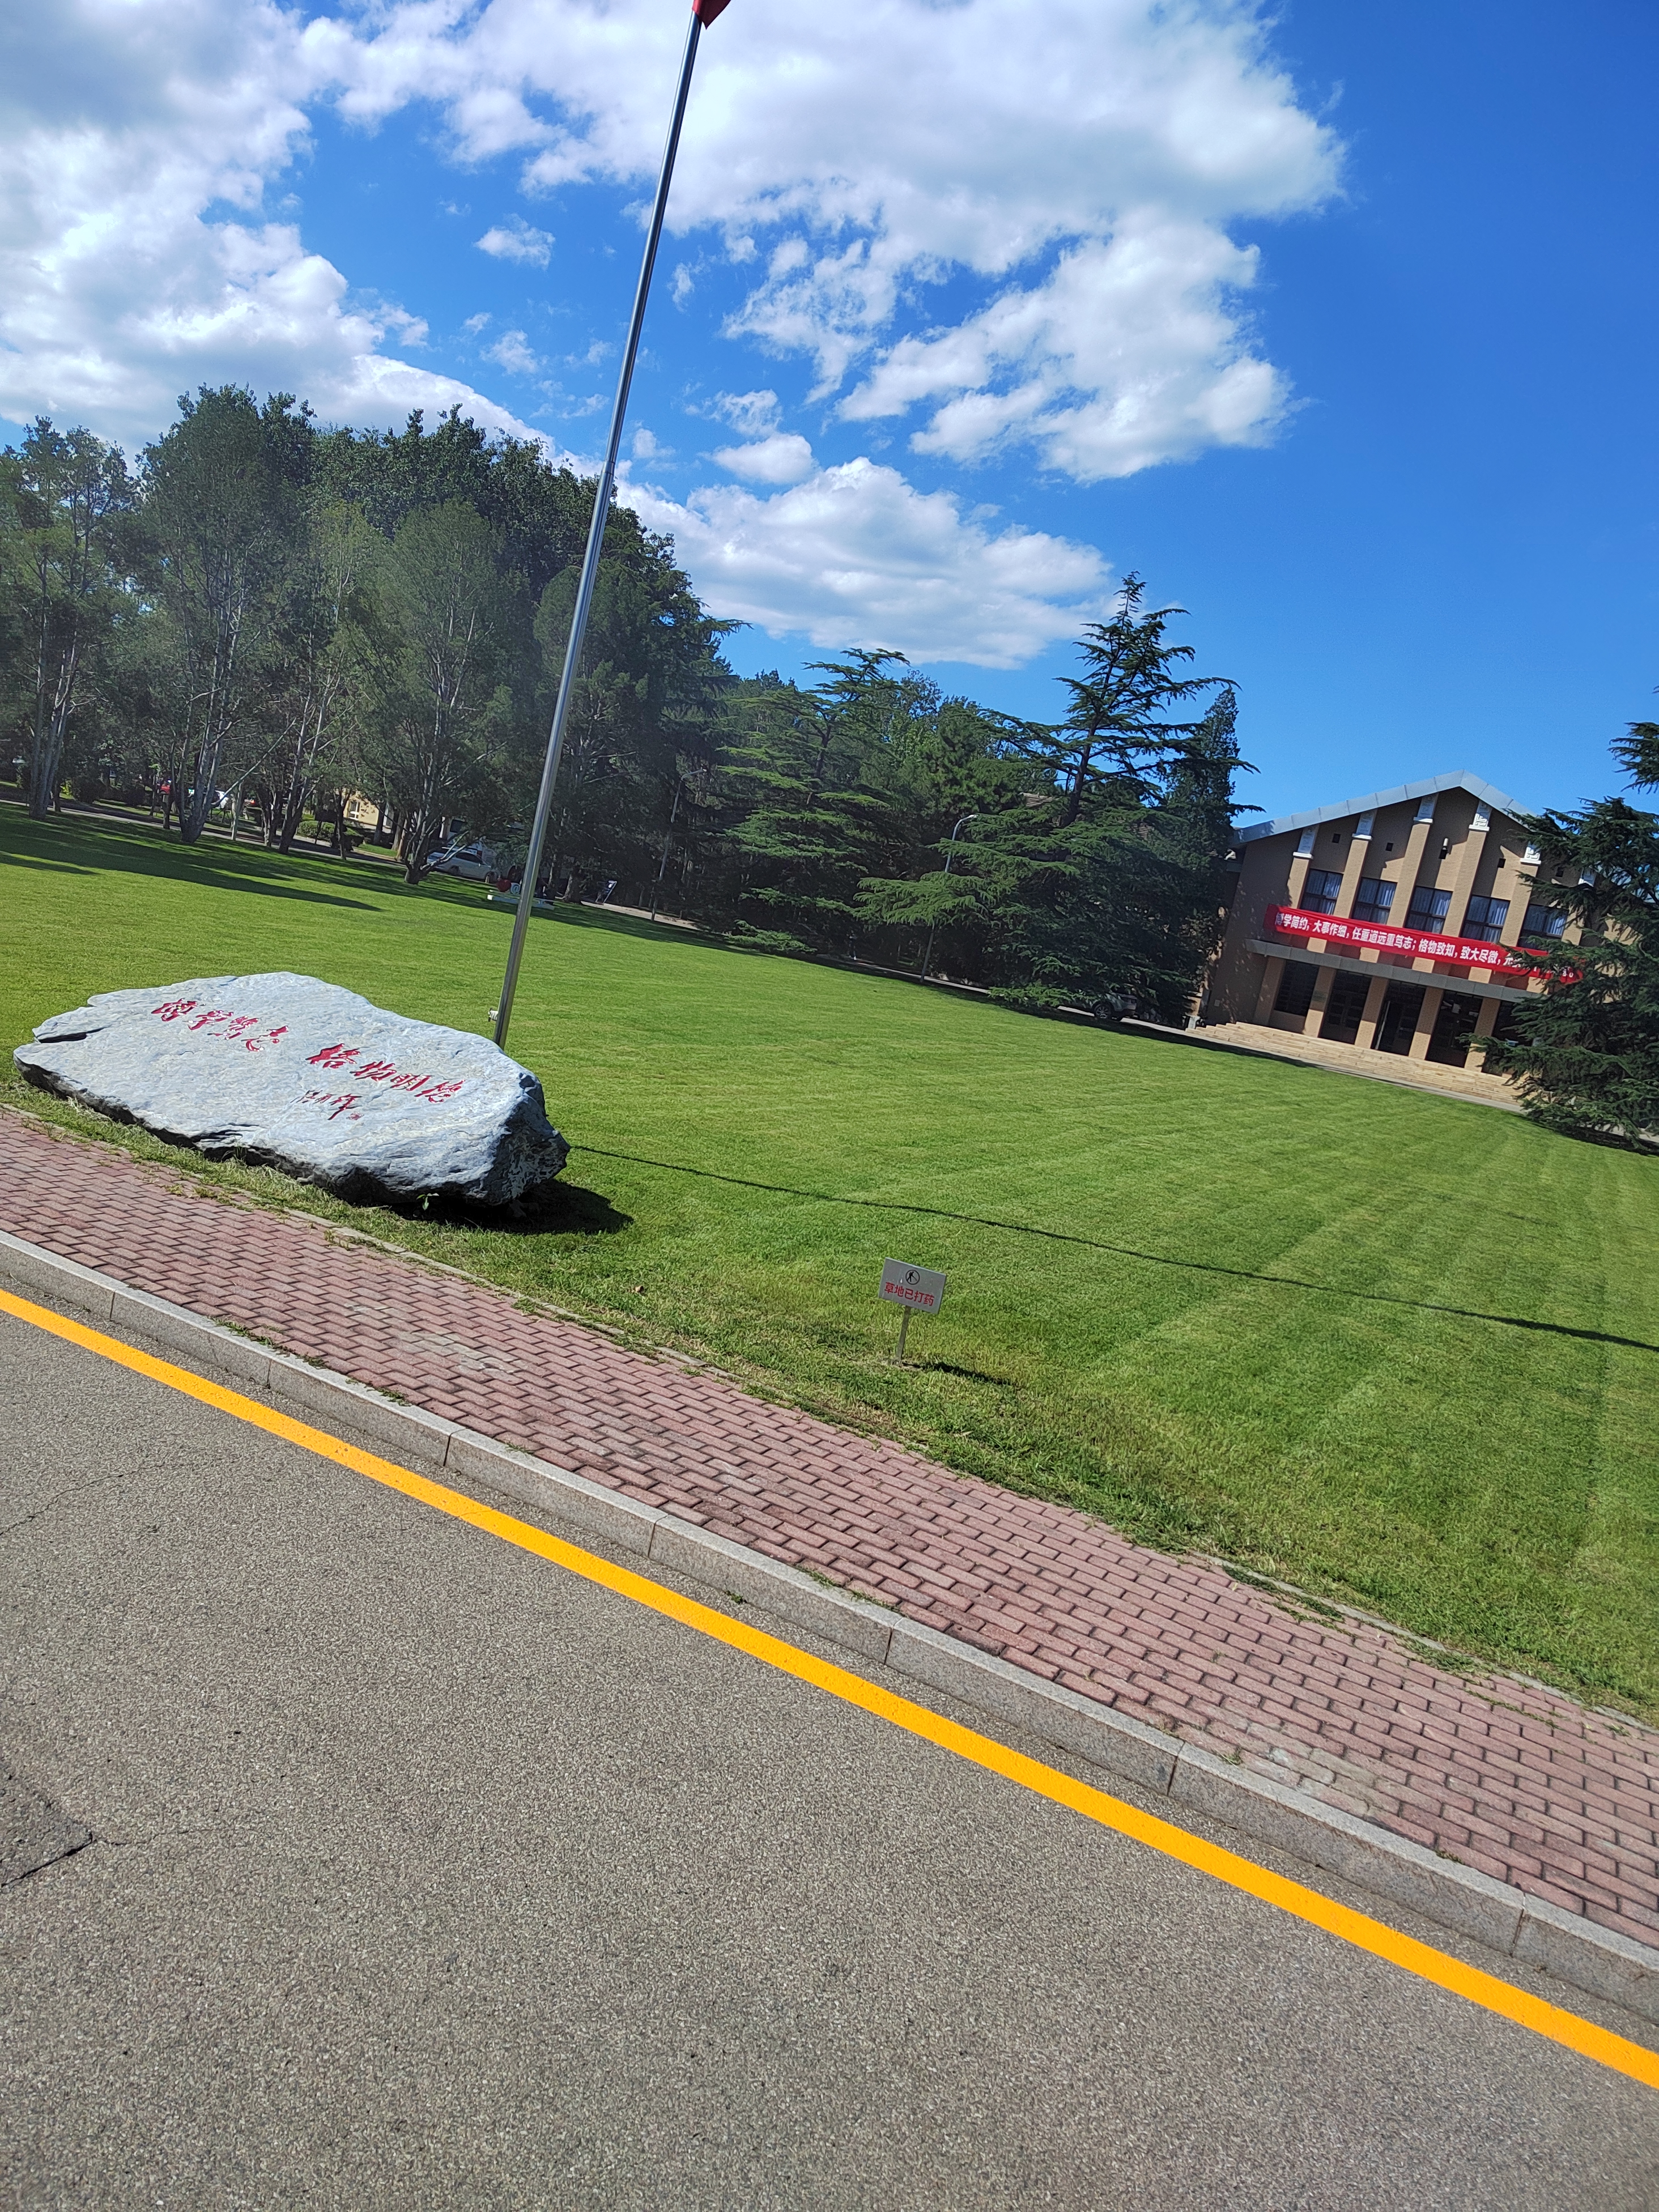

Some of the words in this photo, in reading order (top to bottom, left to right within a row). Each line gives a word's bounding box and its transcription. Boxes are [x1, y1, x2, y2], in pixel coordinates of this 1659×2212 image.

[884, 1282, 935, 1307] 草地已打药
